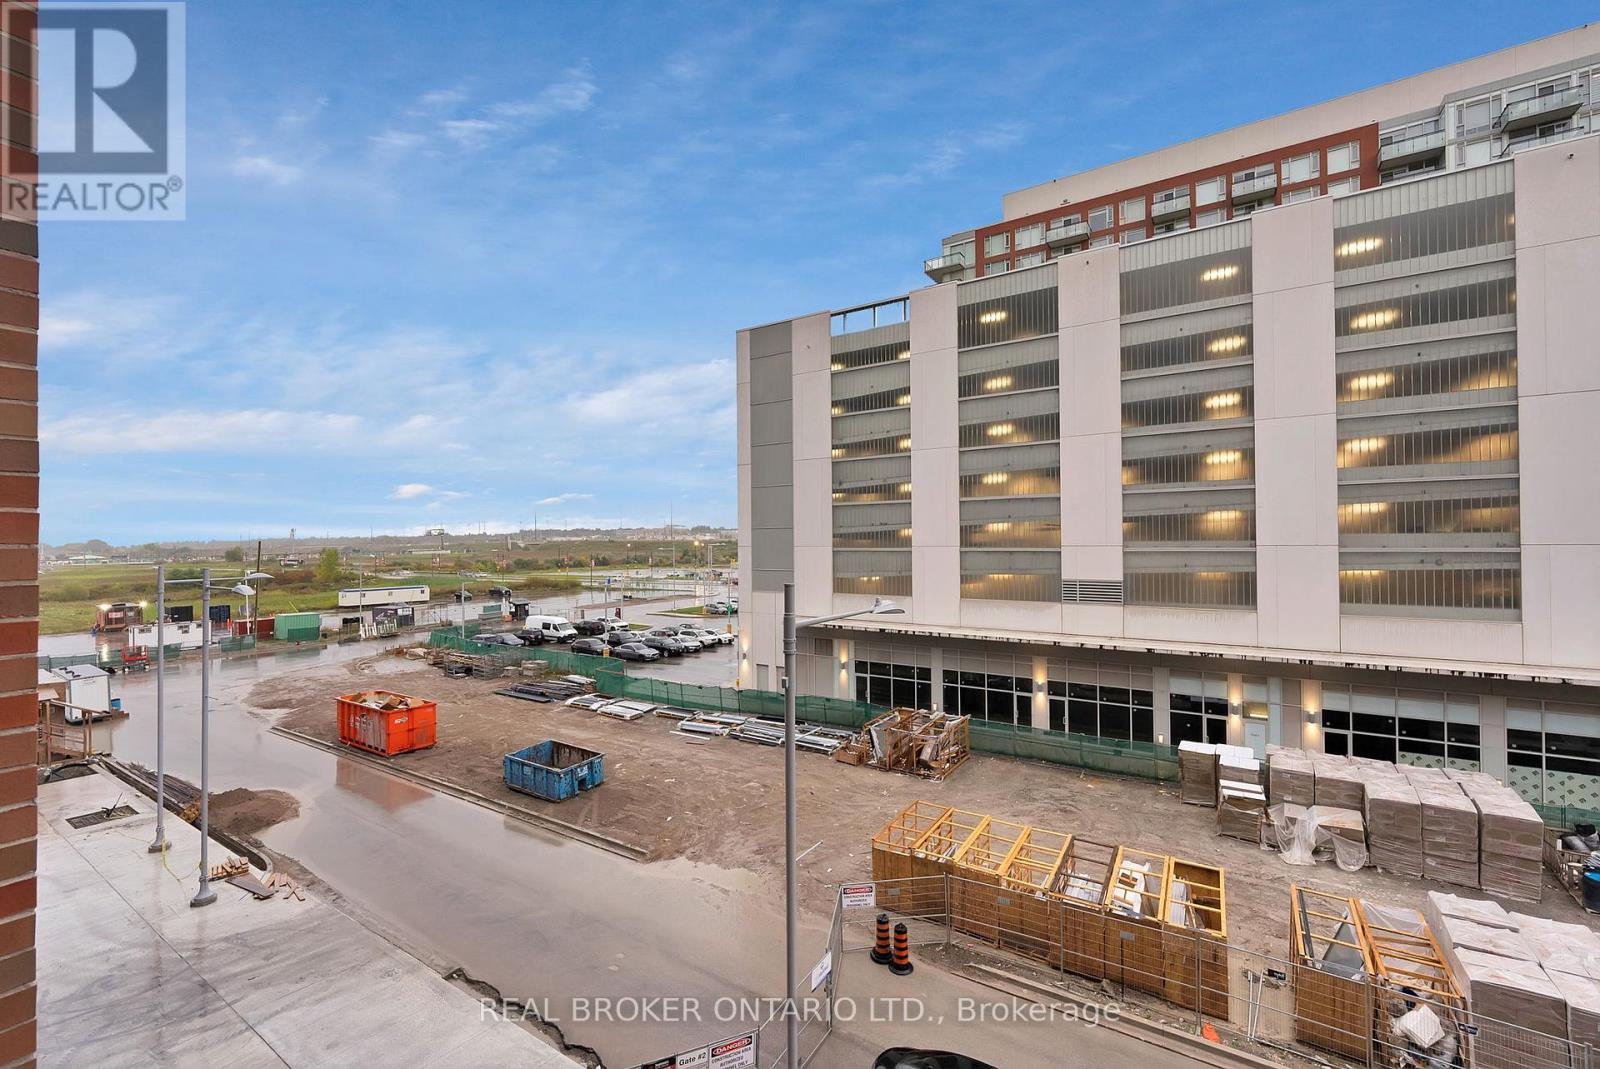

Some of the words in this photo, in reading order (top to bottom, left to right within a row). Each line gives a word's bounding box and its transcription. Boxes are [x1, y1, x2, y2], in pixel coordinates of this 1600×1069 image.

[716, 1039, 748, 1053] DANGER
[679, 1056, 697, 1066] Gate
[697, 1052, 707, 1060] #2
